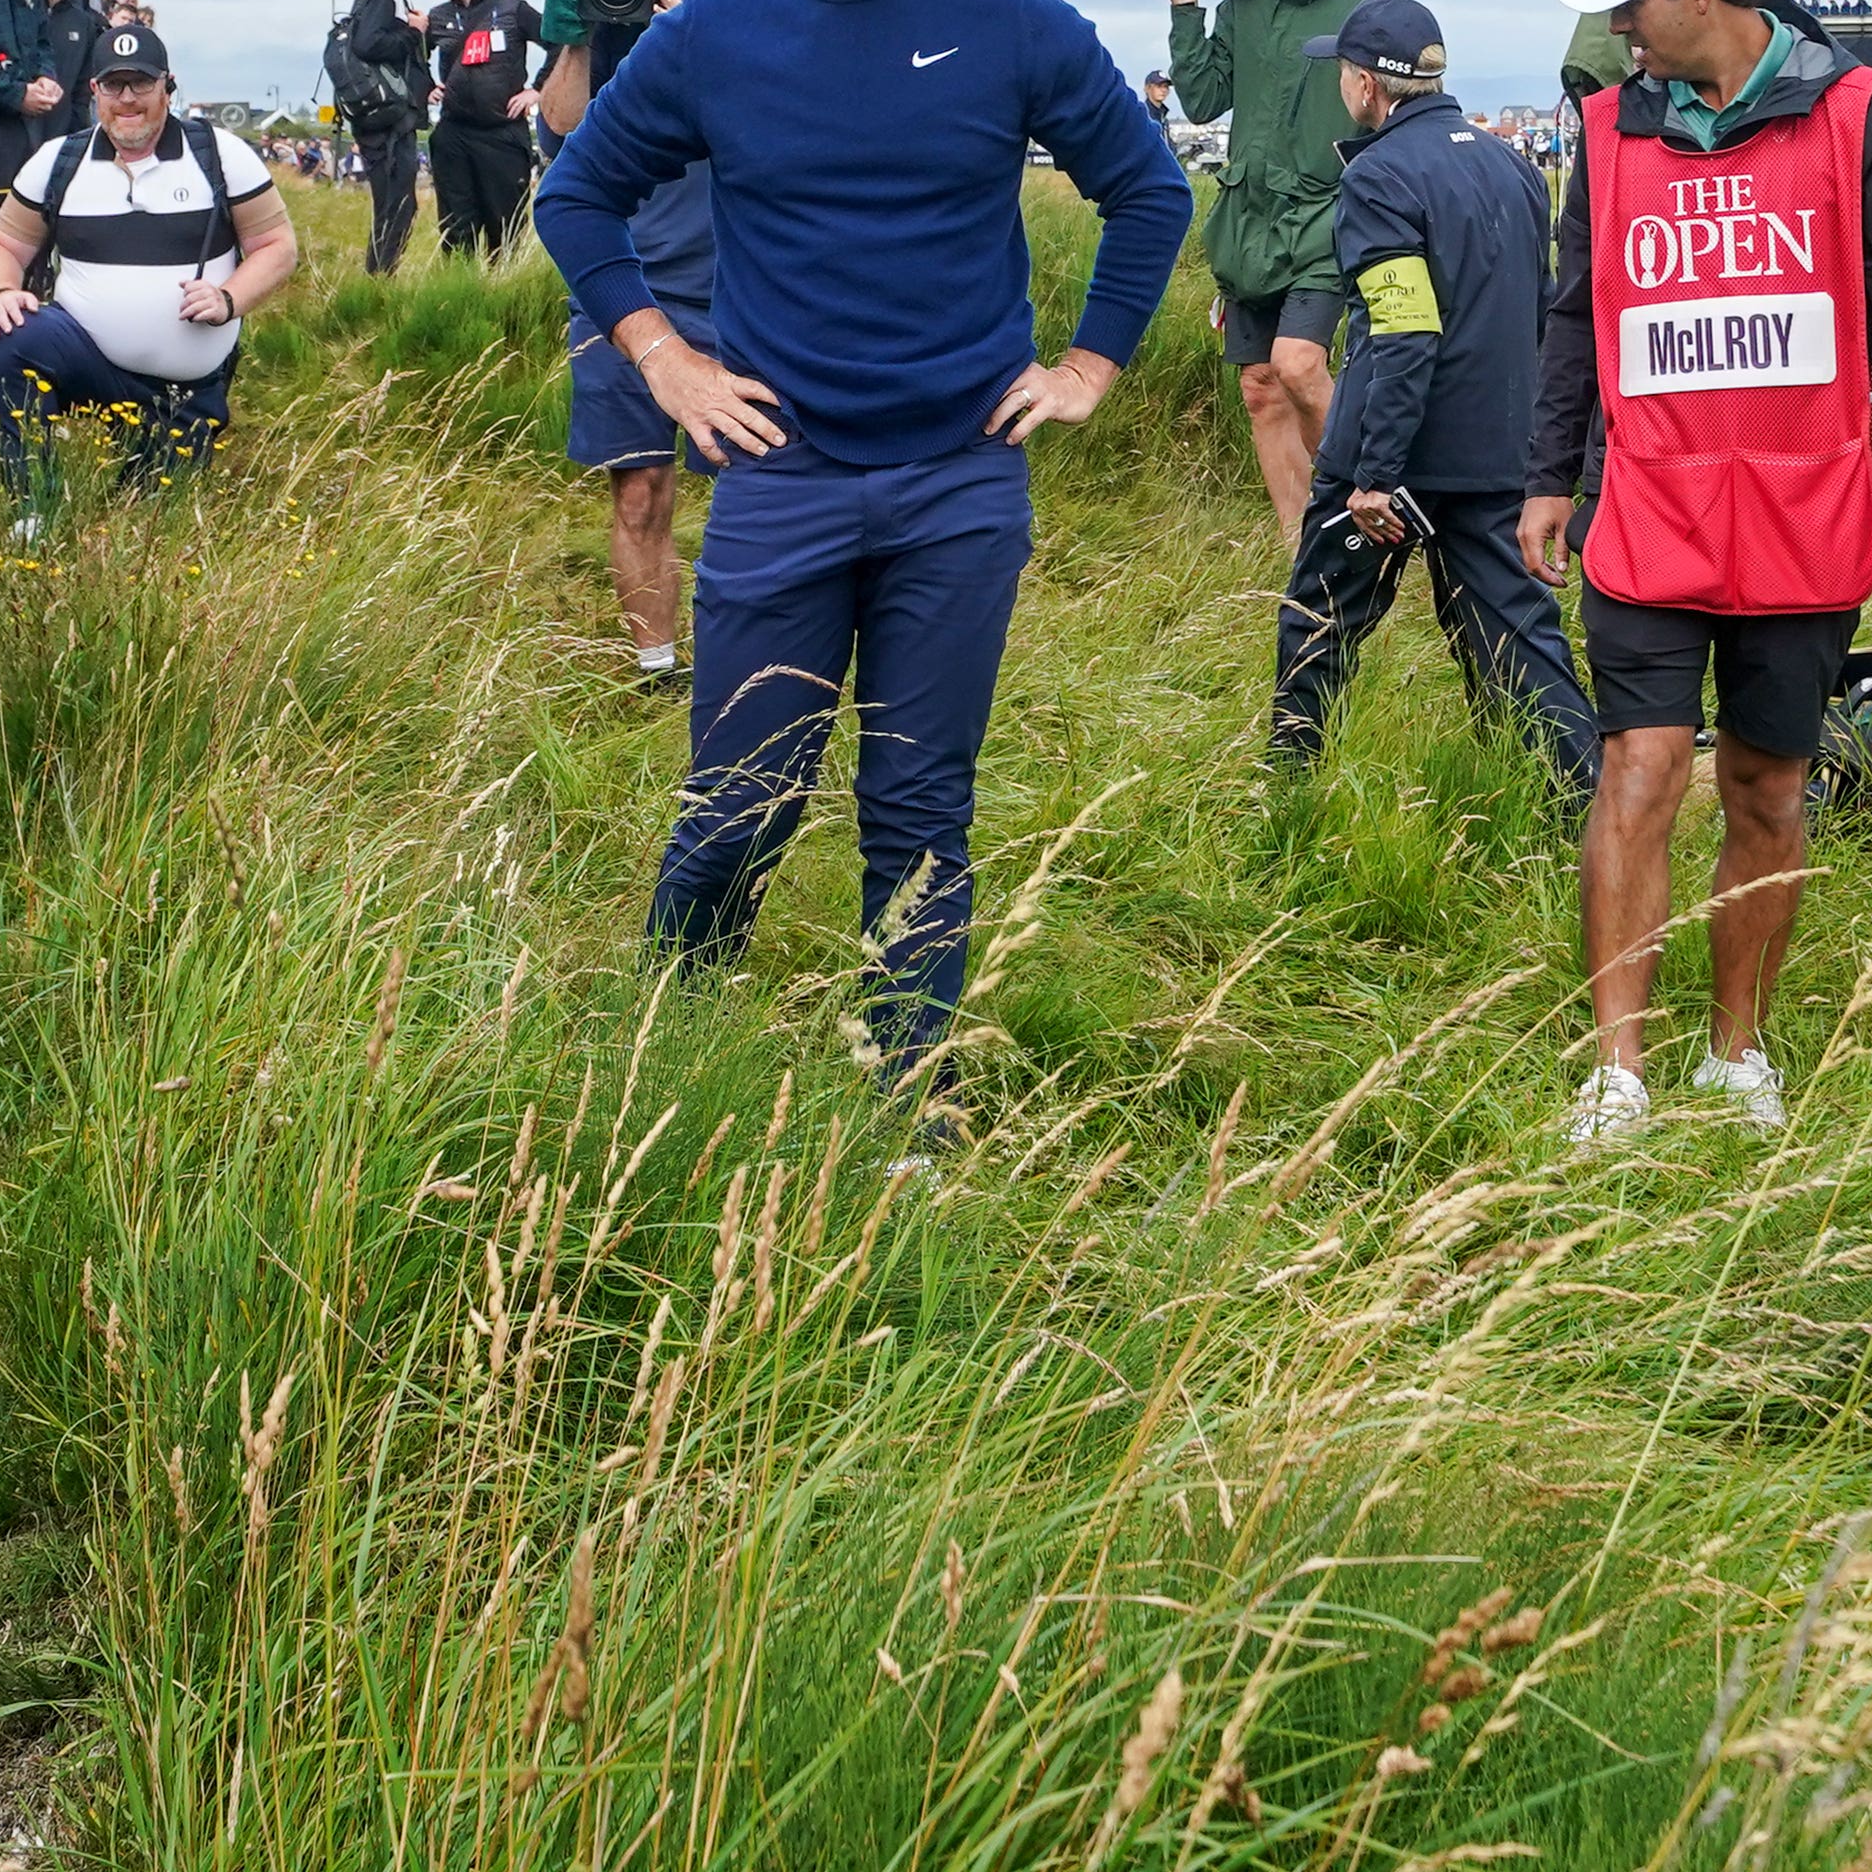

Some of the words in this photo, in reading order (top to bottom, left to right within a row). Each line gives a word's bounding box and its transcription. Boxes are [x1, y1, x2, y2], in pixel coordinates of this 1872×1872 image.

[1377, 56, 1412, 74] BOSS
[1449, 131, 1476, 144] BOSS
[1667, 174, 1757, 217] THE
[1623, 209, 1816, 290] OPEN
[1647, 312, 1794, 377] McILROY
